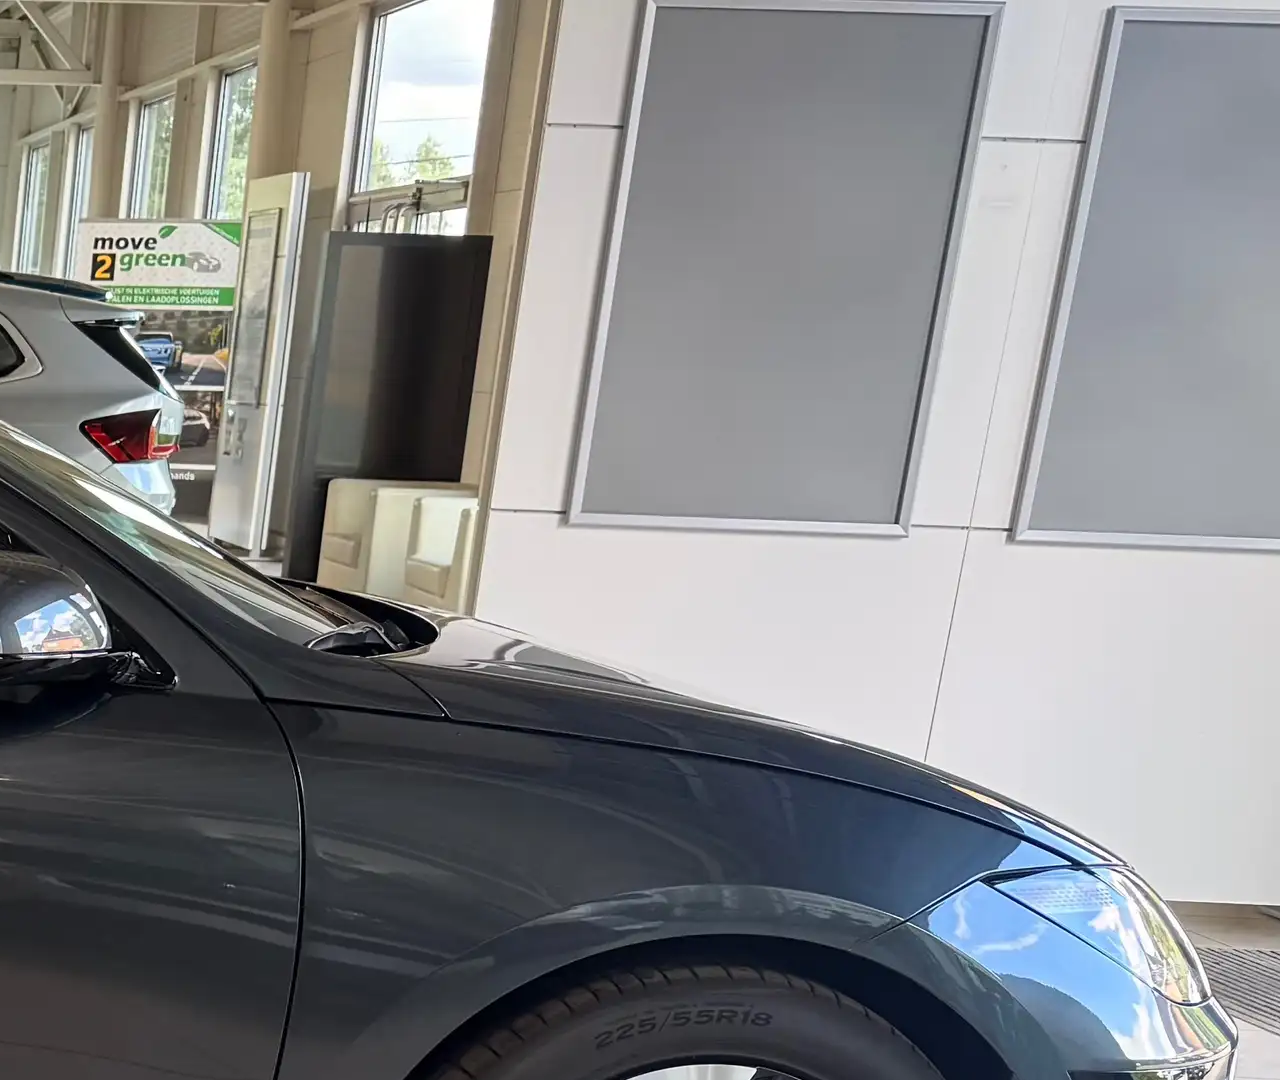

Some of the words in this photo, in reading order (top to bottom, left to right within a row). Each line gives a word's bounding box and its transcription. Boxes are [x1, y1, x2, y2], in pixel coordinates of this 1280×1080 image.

[92, 236, 158, 250] move
[94, 254, 113, 279] 2
[120, 253, 187, 272] green
[594, 1008, 773, 1050] 225/55R18
